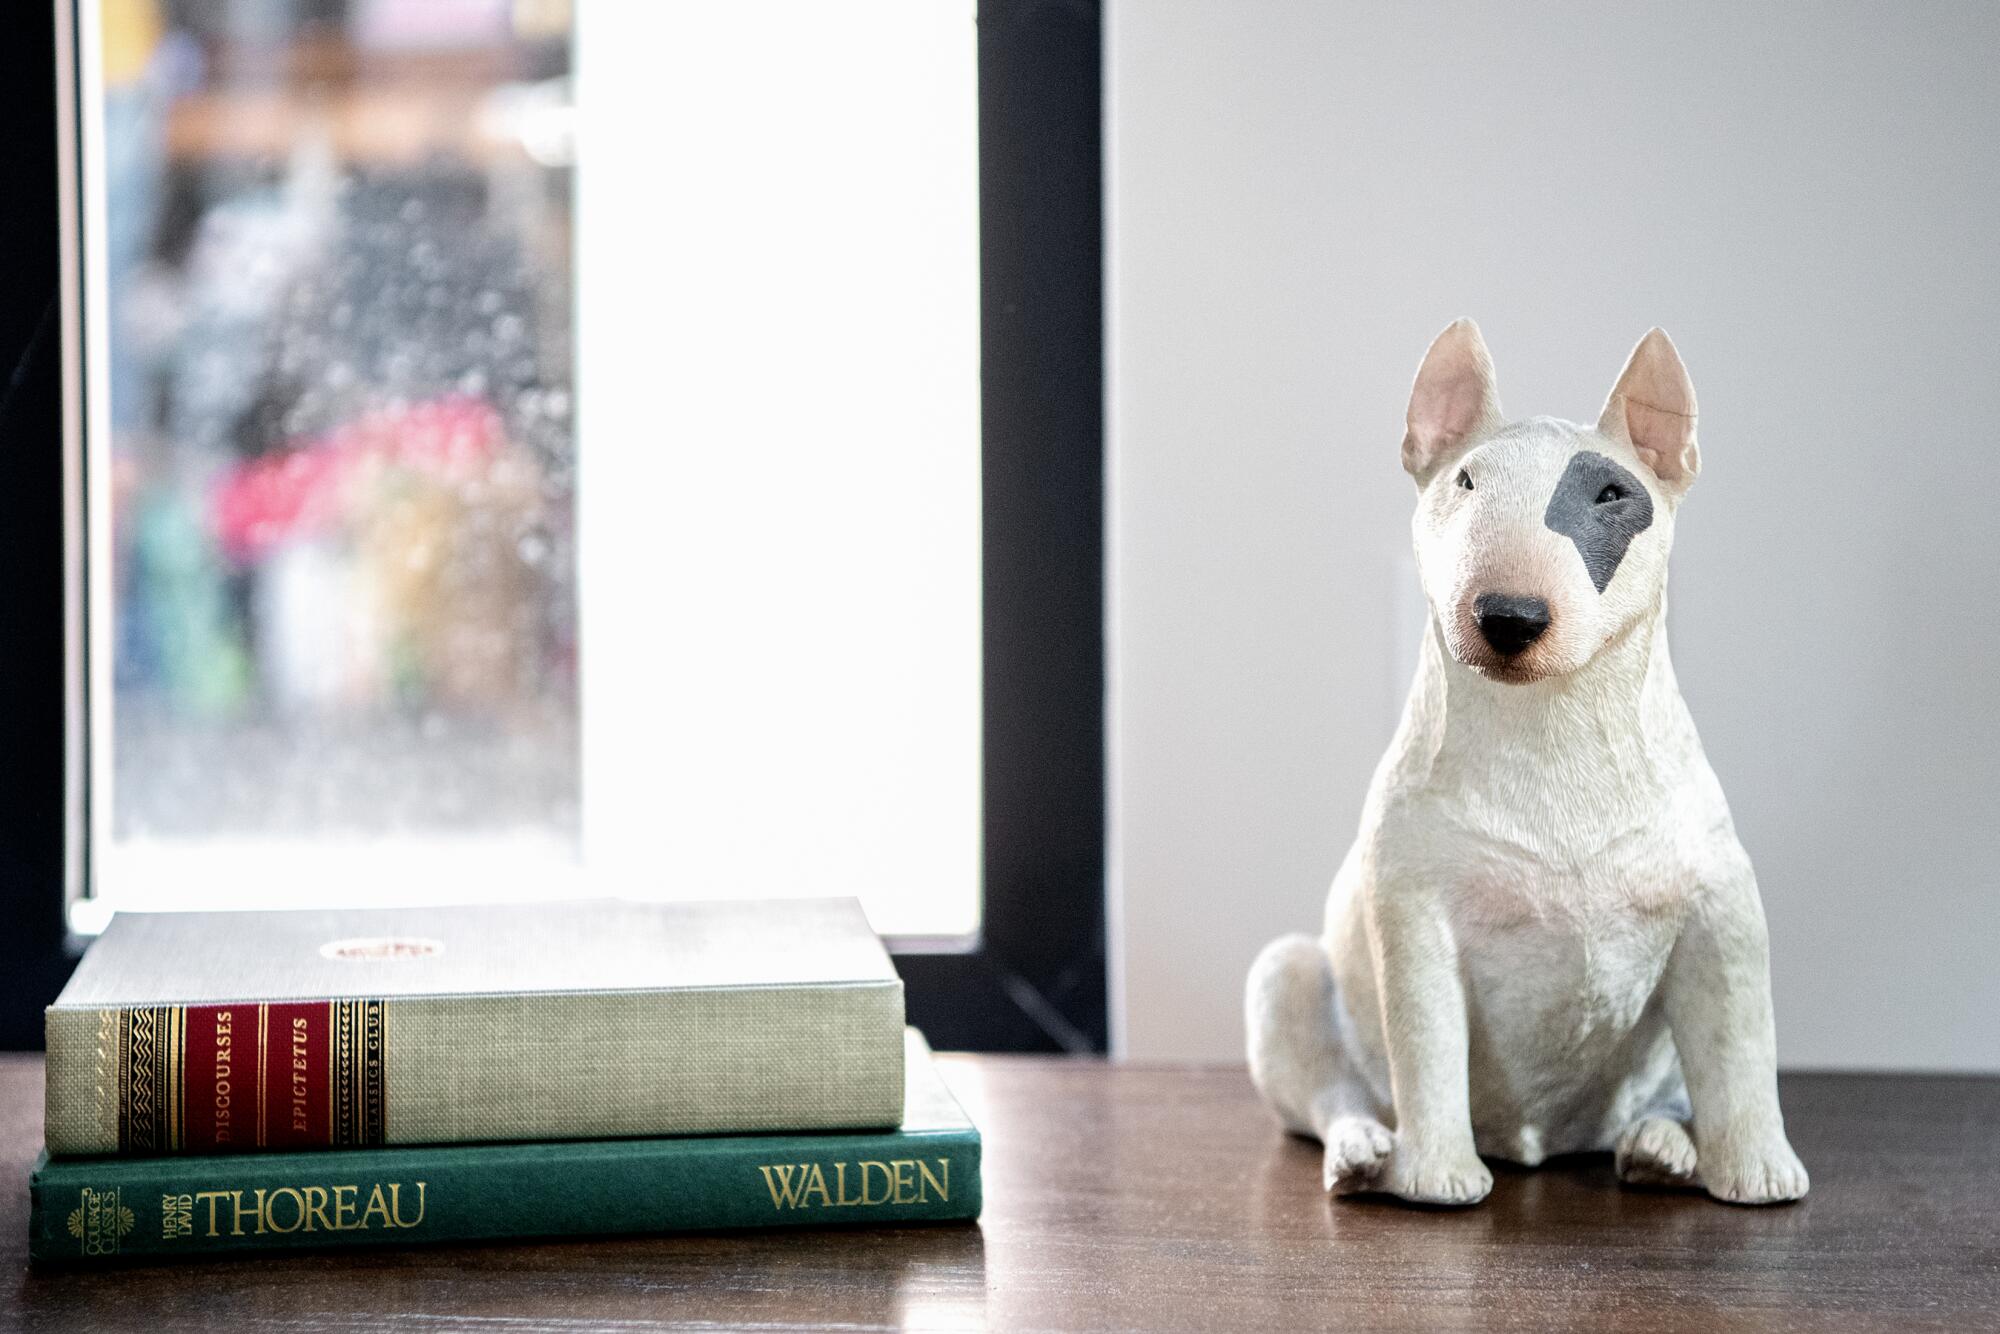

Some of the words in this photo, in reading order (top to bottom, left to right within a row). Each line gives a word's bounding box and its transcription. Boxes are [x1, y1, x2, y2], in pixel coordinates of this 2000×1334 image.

[368, 1004, 379, 1050] CLUB
[216, 1011, 232, 1143] DISCOURSES
[293, 1017, 307, 1132] EPICTETUS
[195, 1182, 427, 1237] THOREAU
[758, 1158, 950, 1211] WALDEN
[86, 1190, 101, 1256] COURAGE
[162, 1193, 177, 1240] HENRY
[178, 1193, 193, 1236] DAVID
